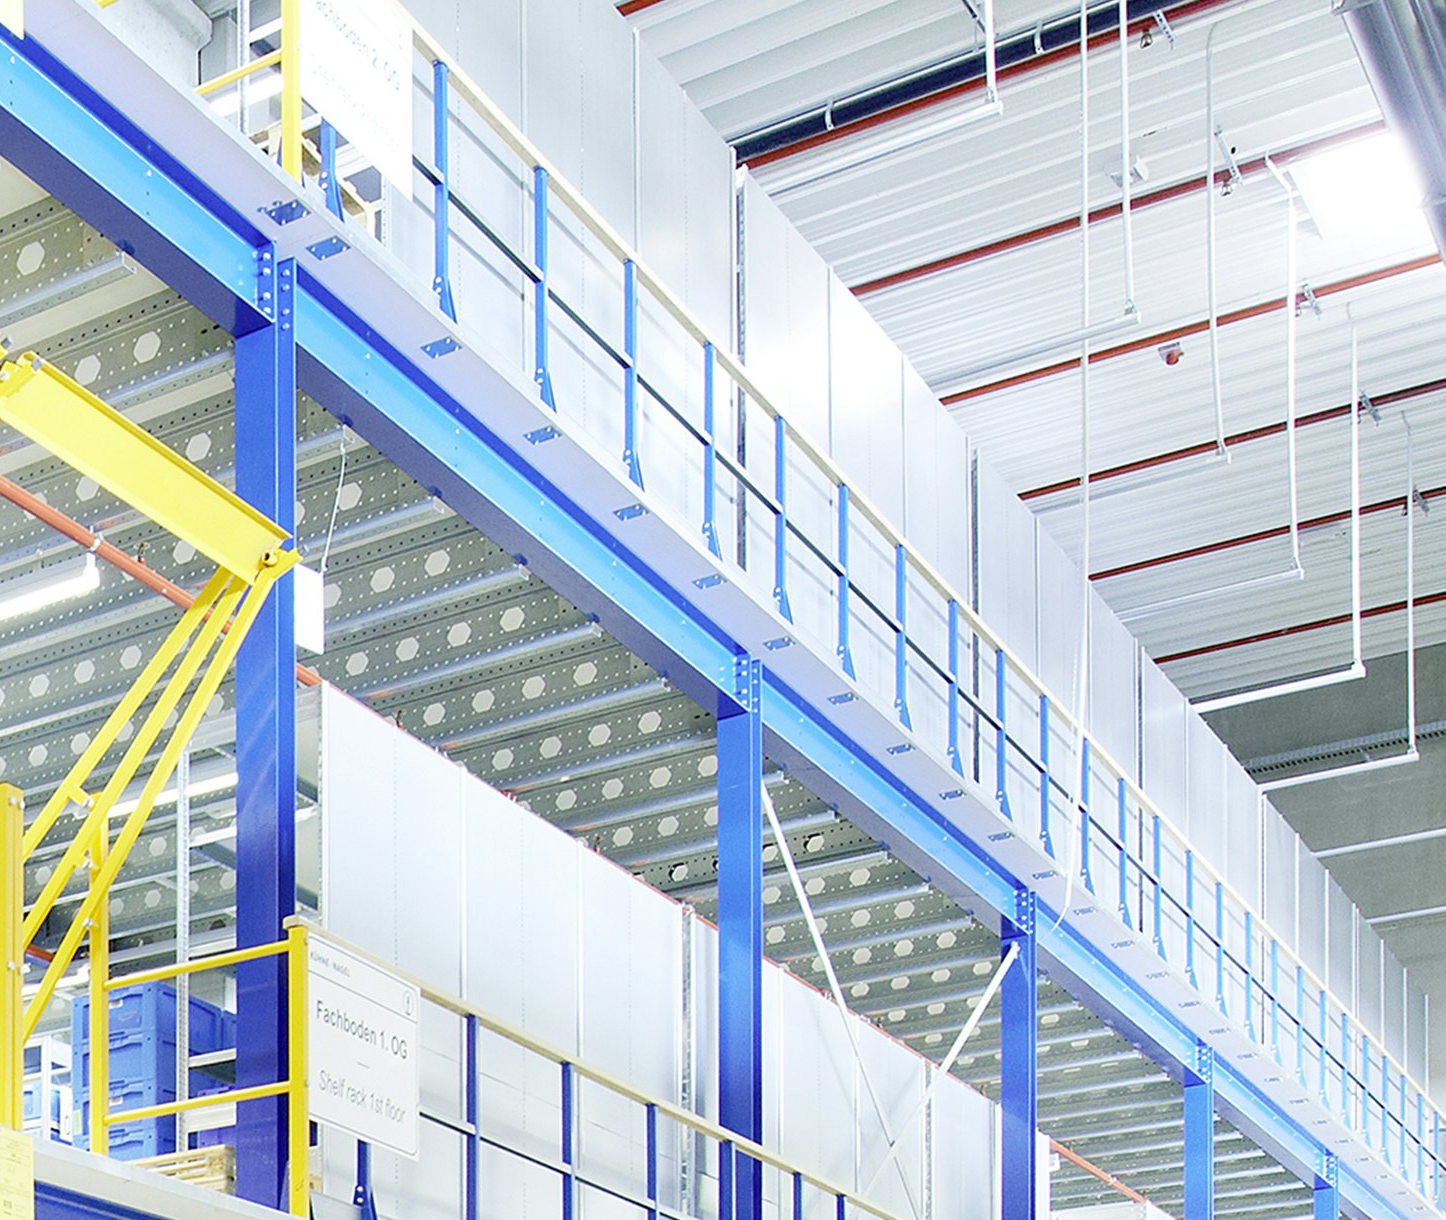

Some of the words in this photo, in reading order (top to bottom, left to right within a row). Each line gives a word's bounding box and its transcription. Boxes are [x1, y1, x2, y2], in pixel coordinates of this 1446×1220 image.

[316, 1000, 377, 1046] Fachboden
[380, 1030, 388, 1052] 1.
[391, 1035, 408, 1060] OG
[318, 1069, 346, 1097] Shelf
[346, 1086, 367, 1109] rack
[370, 1093, 383, 1116] 1st
[385, 1098, 407, 1123] floor
